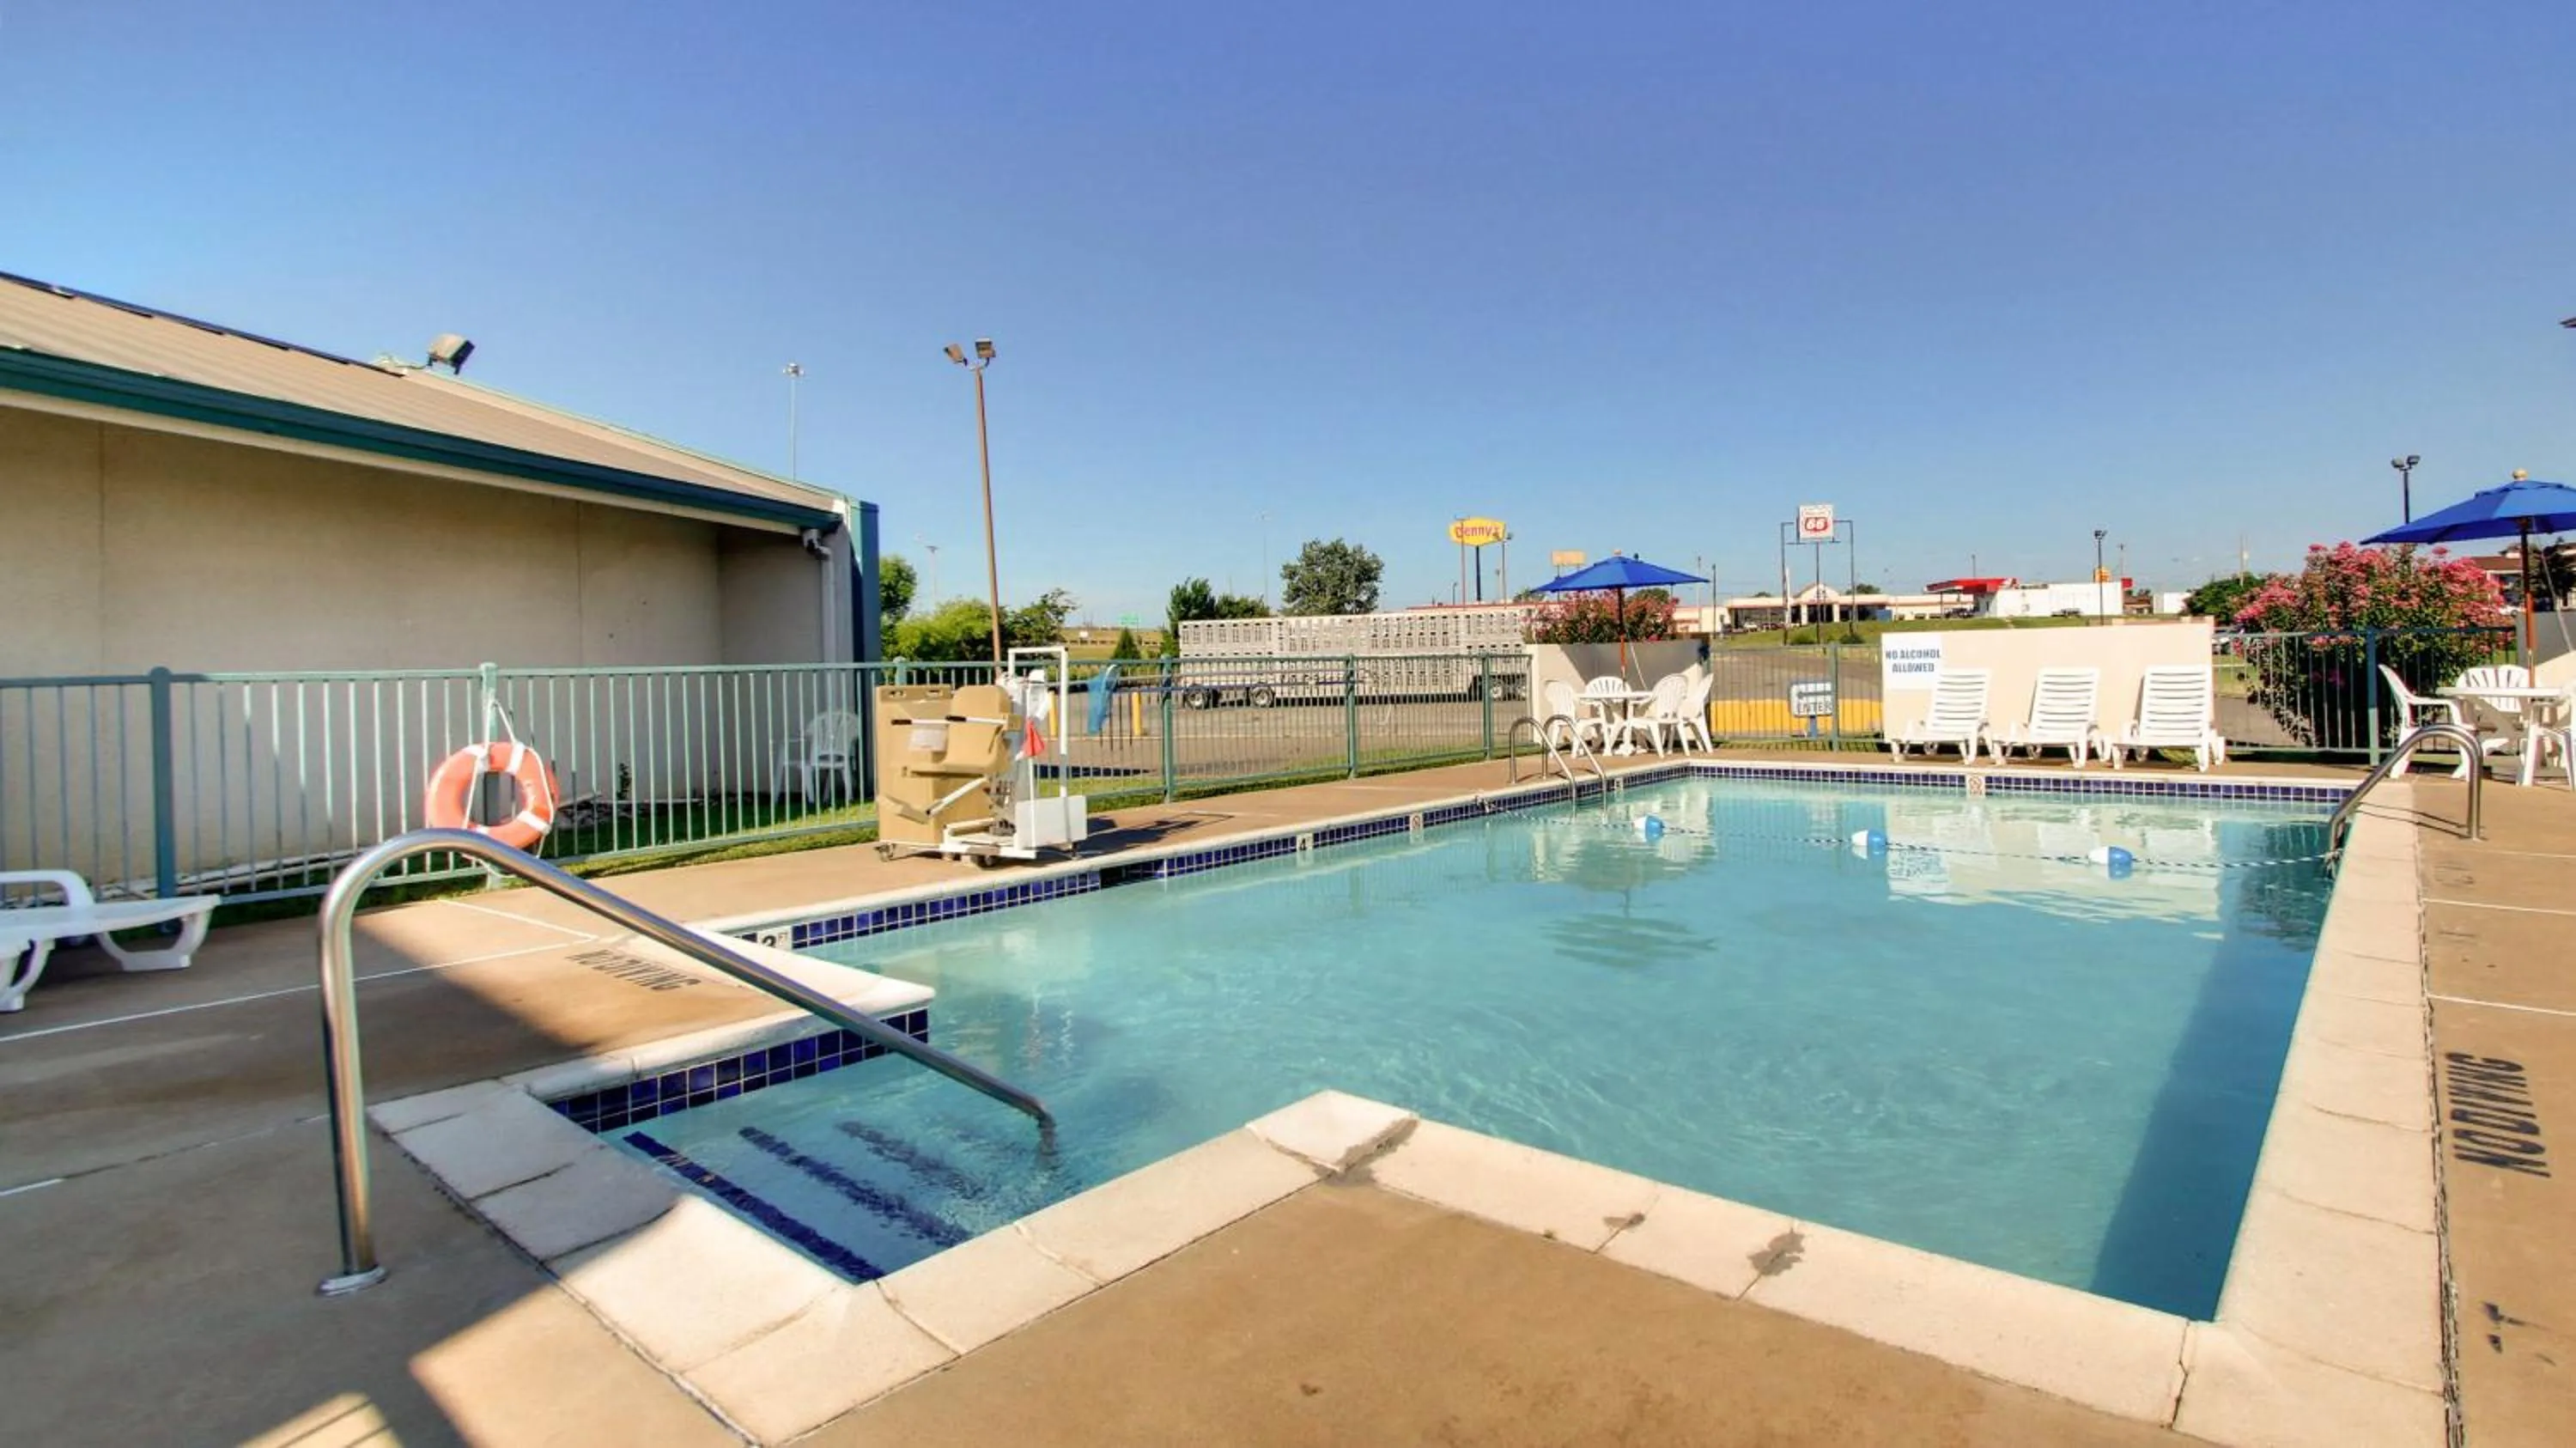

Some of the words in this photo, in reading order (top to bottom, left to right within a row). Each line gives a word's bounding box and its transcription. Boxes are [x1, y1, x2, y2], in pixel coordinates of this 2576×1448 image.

[1886, 649, 1898, 660] NO
[1899, 648, 1940, 660] ALCOHOL
[1892, 662, 1935, 672] ALLOWED
